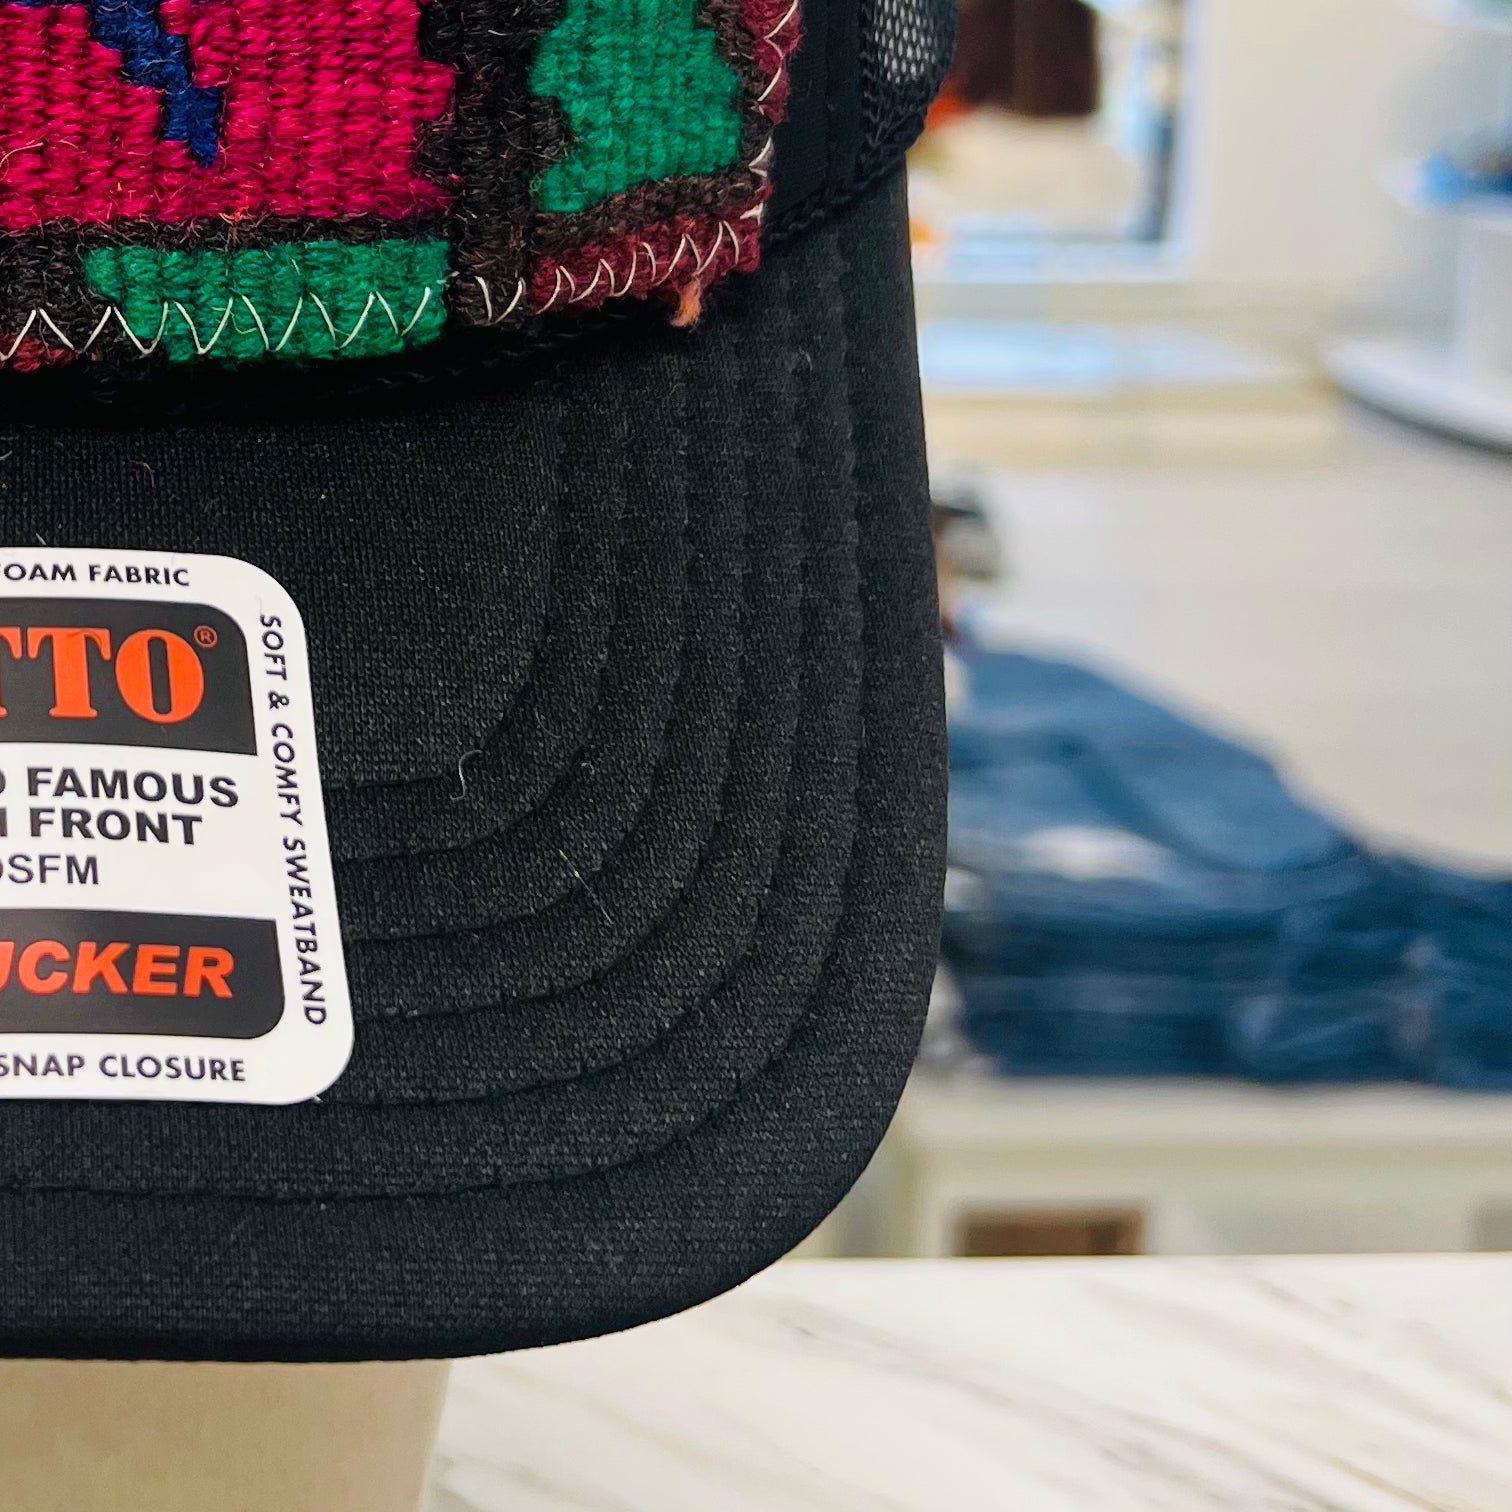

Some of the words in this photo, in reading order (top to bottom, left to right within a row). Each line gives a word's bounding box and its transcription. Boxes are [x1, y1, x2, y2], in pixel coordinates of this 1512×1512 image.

[89, 564, 189, 586] FABRIC
[260, 614, 288, 681] SOFT
[269, 692, 290, 710] &
[28, 768, 239, 807] FAMOUS
[271, 723, 304, 827] COMFY
[30, 808, 202, 844] FRONT
[282, 838, 327, 1025] SWEATBAND
[99, 1055, 246, 1081] CLOSURE
